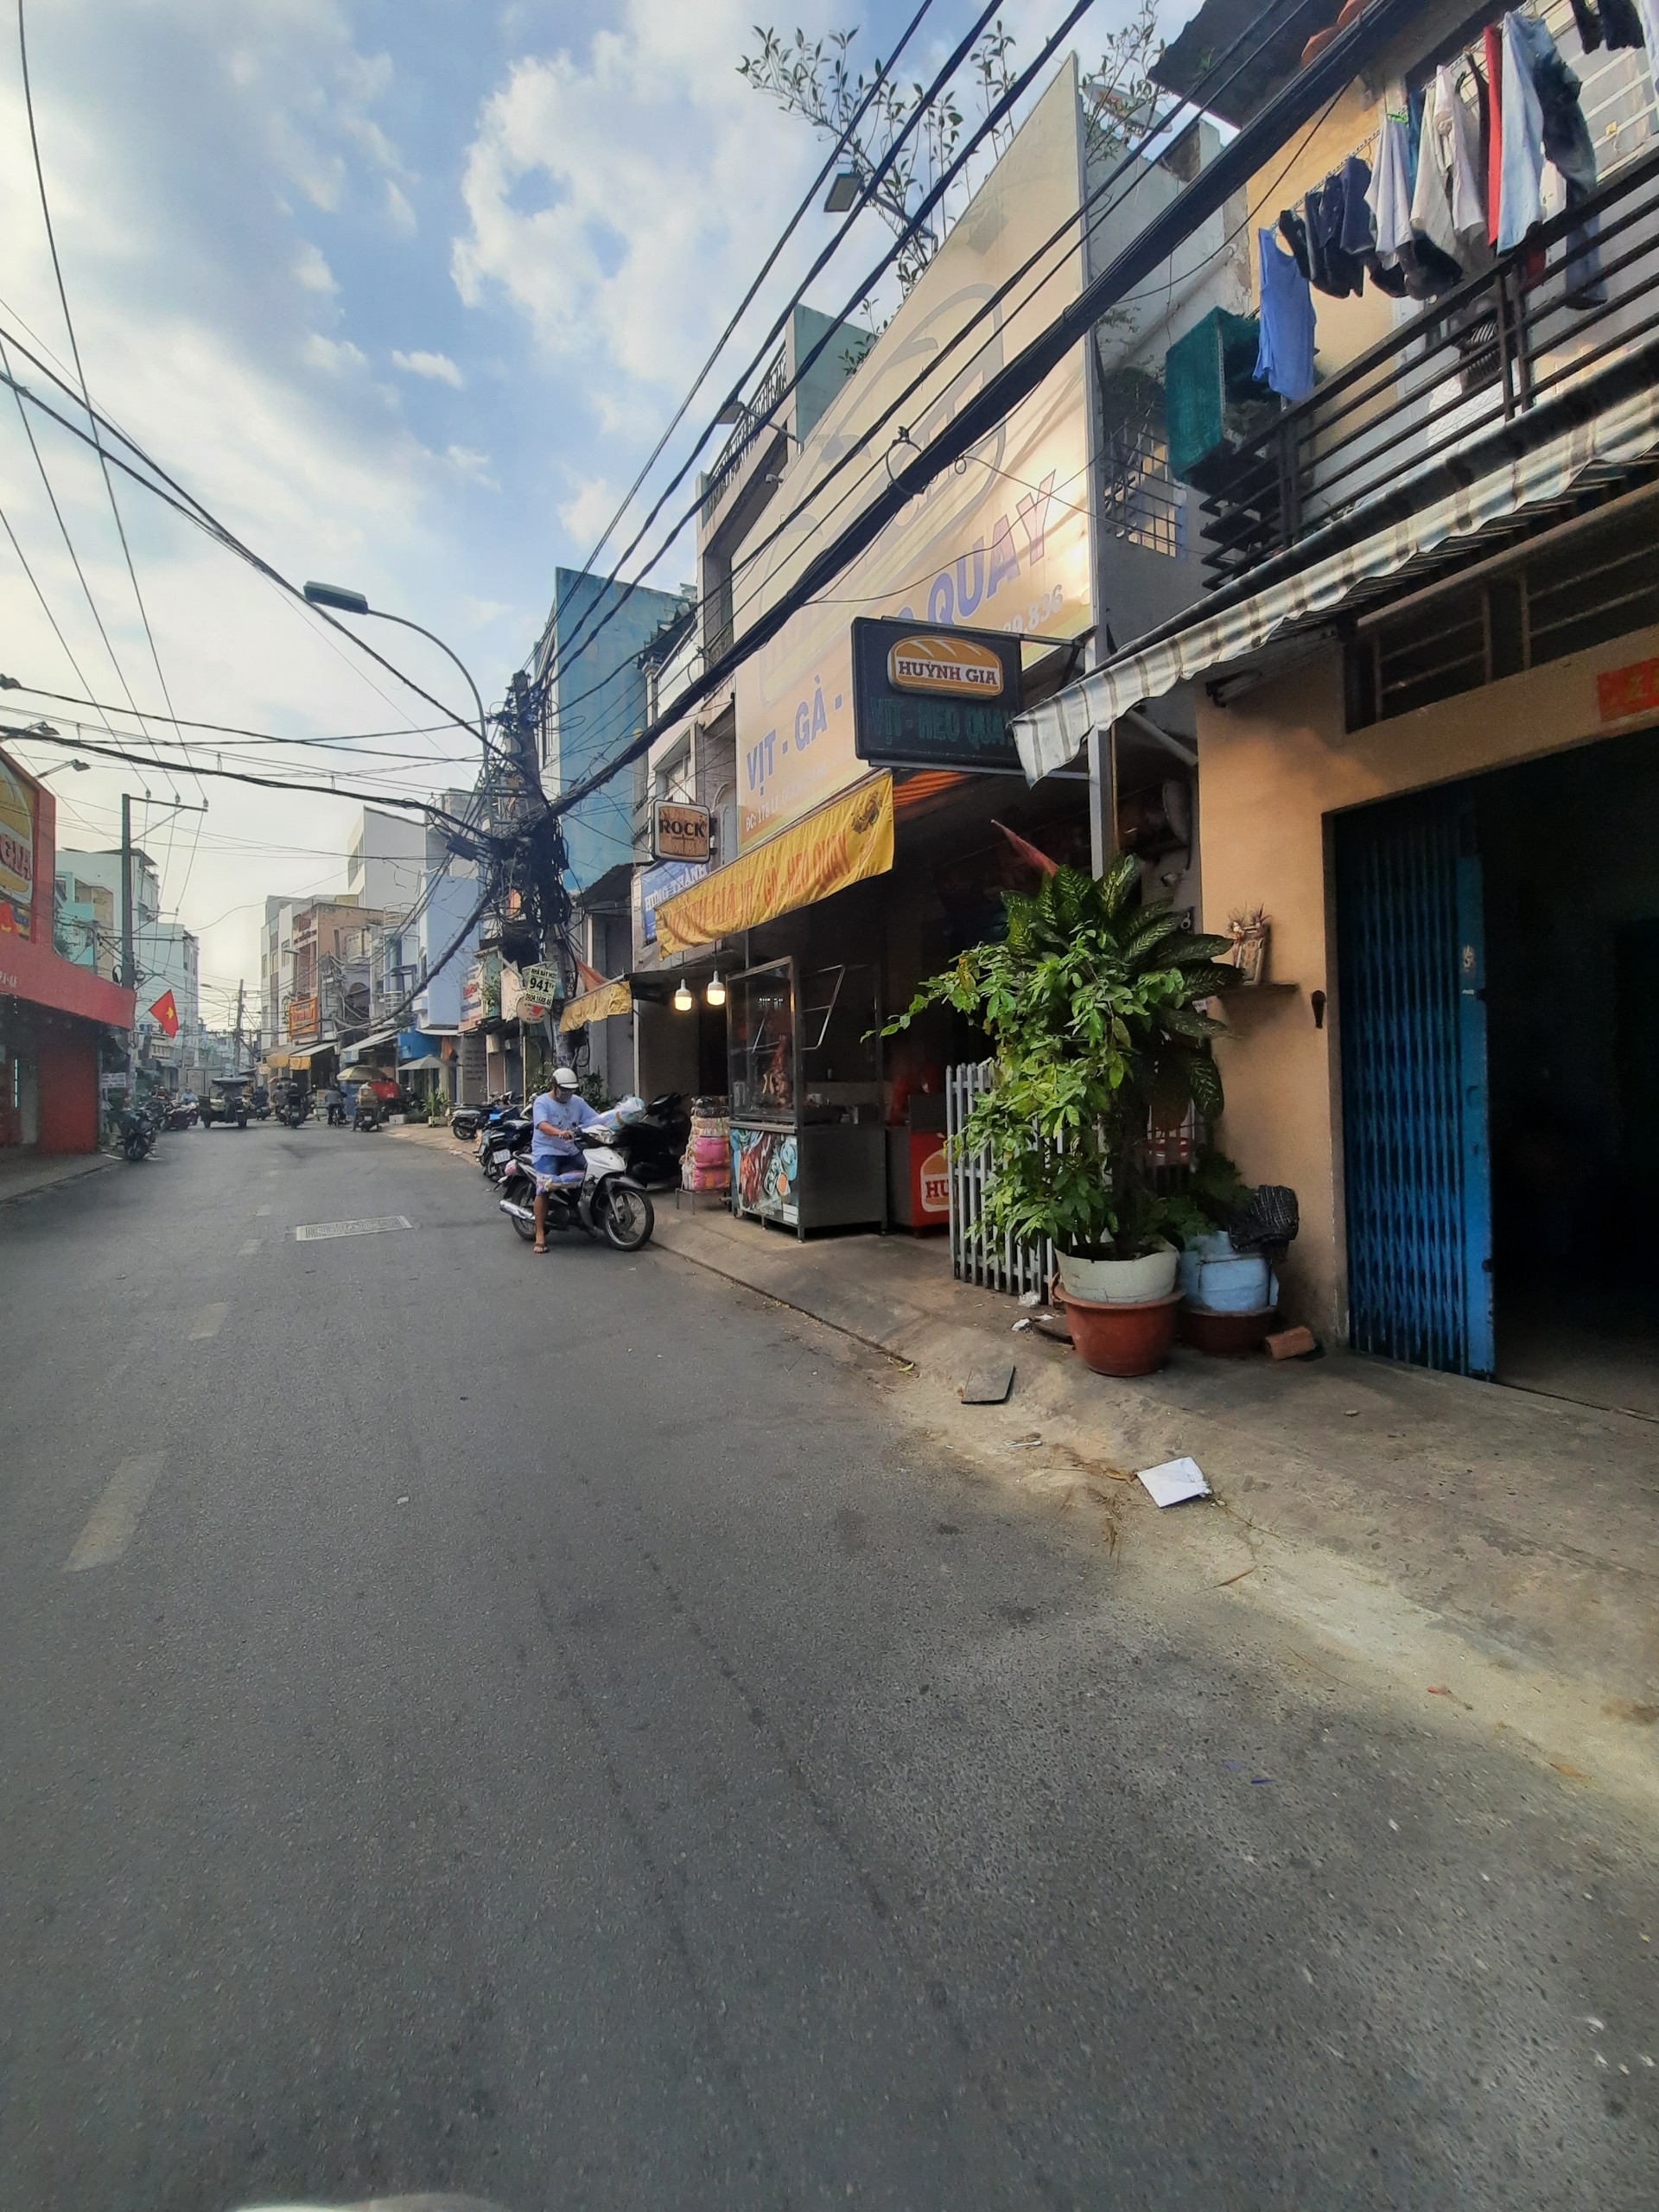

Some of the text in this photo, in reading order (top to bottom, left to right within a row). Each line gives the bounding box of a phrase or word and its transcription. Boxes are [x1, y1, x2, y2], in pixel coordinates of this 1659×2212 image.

[747, 728, 776, 797] VỊT
[794, 674, 828, 752] GÀ
[927, 468, 1056, 627] QUAY
[898, 660, 998, 685] HUỲNH GIA
[659, 819, 705, 838] ROCK
